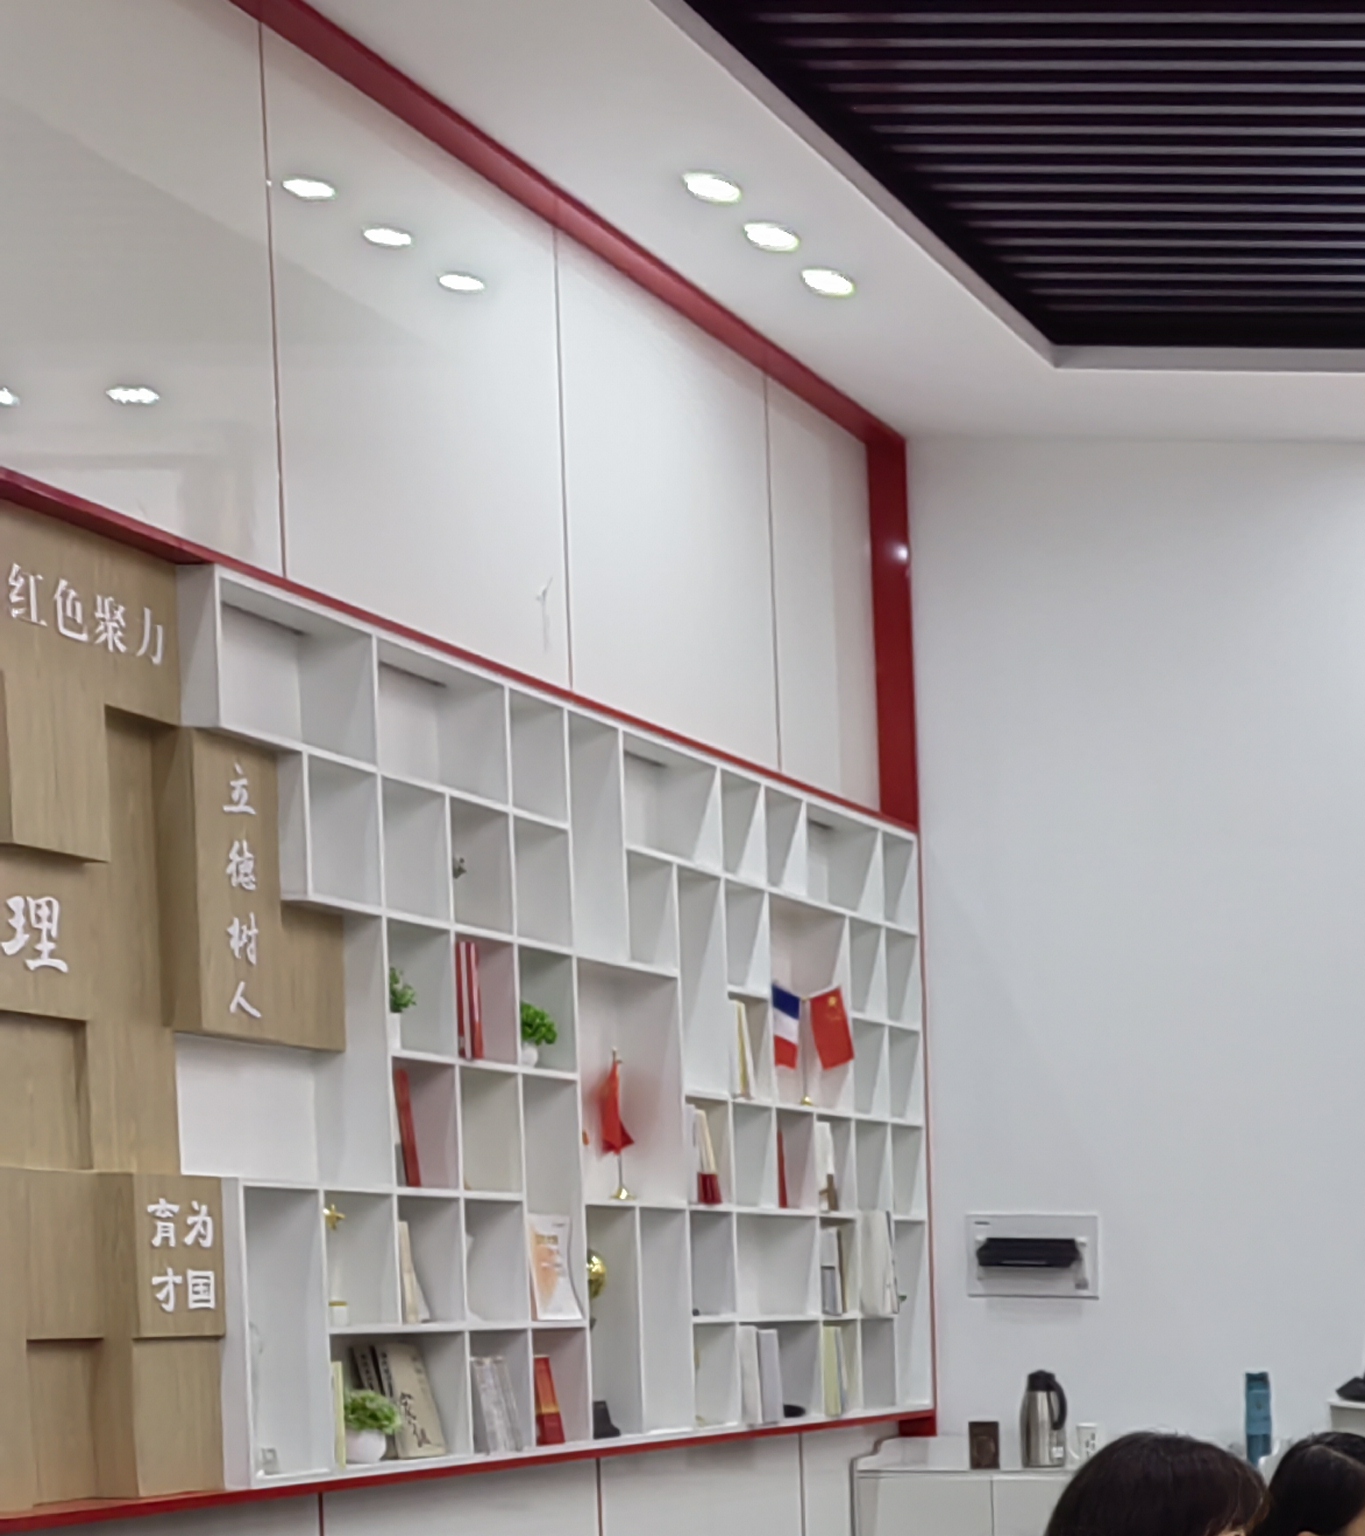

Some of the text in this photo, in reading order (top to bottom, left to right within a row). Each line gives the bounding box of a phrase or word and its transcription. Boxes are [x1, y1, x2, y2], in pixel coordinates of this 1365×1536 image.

[7, 562, 164, 666] 红色聚力
[1, 895, 69, 973] 理
[223, 763, 262, 1019] 立德树人
